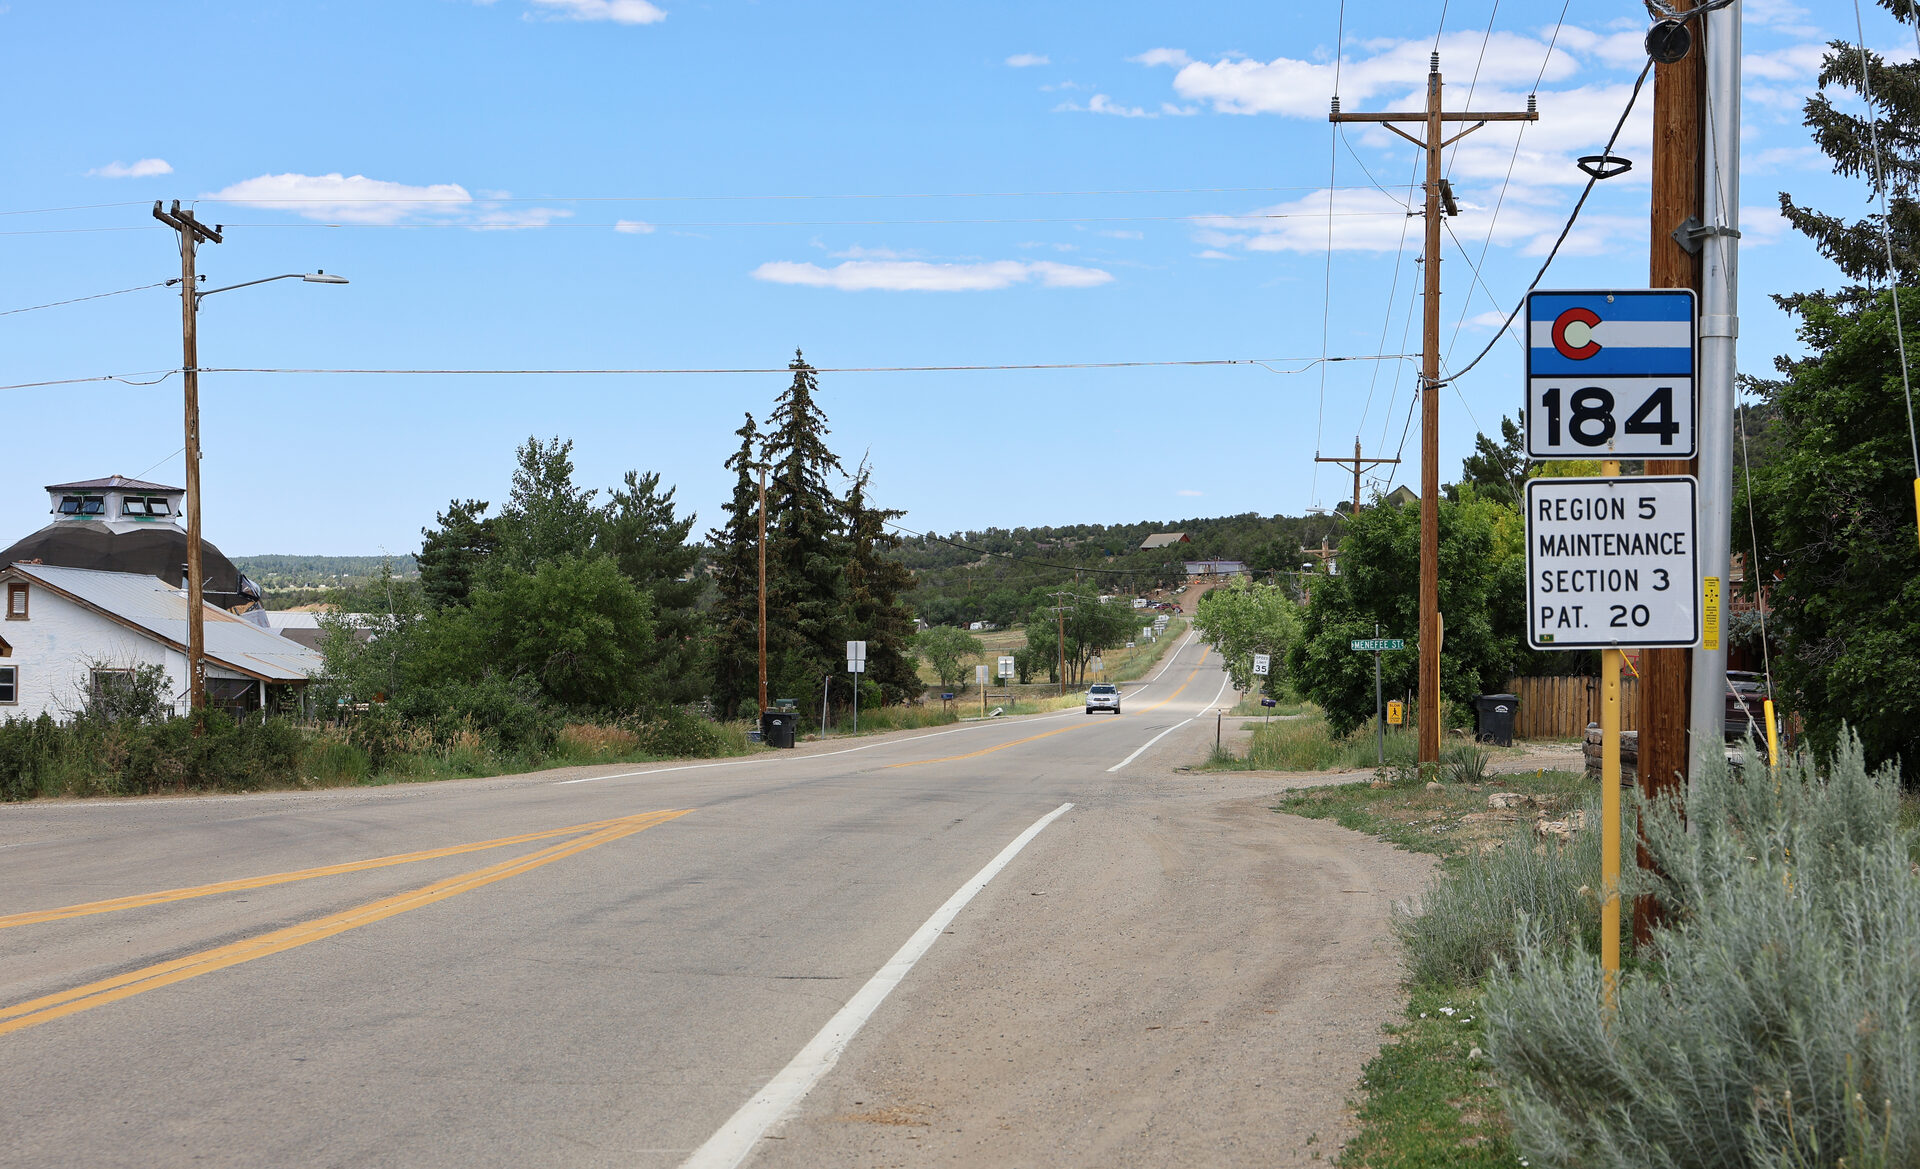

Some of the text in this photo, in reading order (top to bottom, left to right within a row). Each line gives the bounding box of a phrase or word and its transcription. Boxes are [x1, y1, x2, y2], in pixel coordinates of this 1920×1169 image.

[1551, 307, 1603, 361] C
[1542, 386, 1680, 447] 184
[1539, 497, 1656, 521] REGION 5
[1539, 532, 1686, 557] MAINTENANCE
[1541, 568, 1670, 593] SECTION 3
[1541, 604, 1650, 629] PAT. 20
[1354, 640, 1401, 649] MENEFEE ST
[1255, 665, 1267, 673] 35
